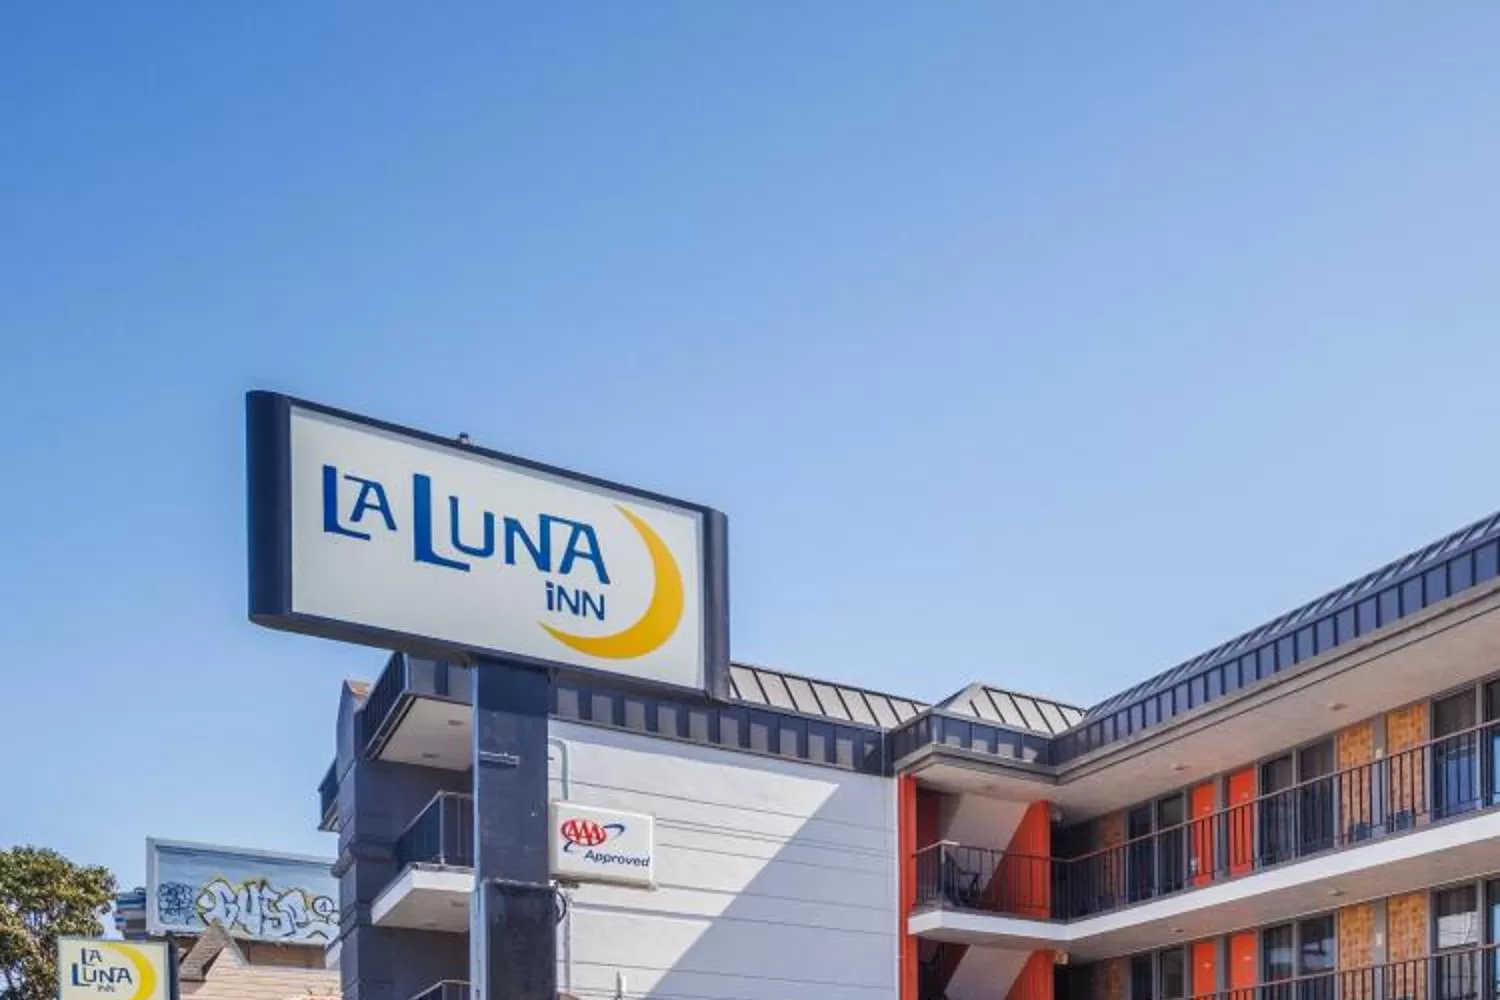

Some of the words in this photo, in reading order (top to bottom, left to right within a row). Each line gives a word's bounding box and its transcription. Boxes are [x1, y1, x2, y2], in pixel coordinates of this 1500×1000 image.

[322, 464, 398, 541] LA
[413, 472, 611, 585] LUNA
[564, 818, 605, 846] AAA
[584, 849, 651, 868] Approved
[81, 947, 103, 967] LA
[71, 962, 133, 987] LUNA
